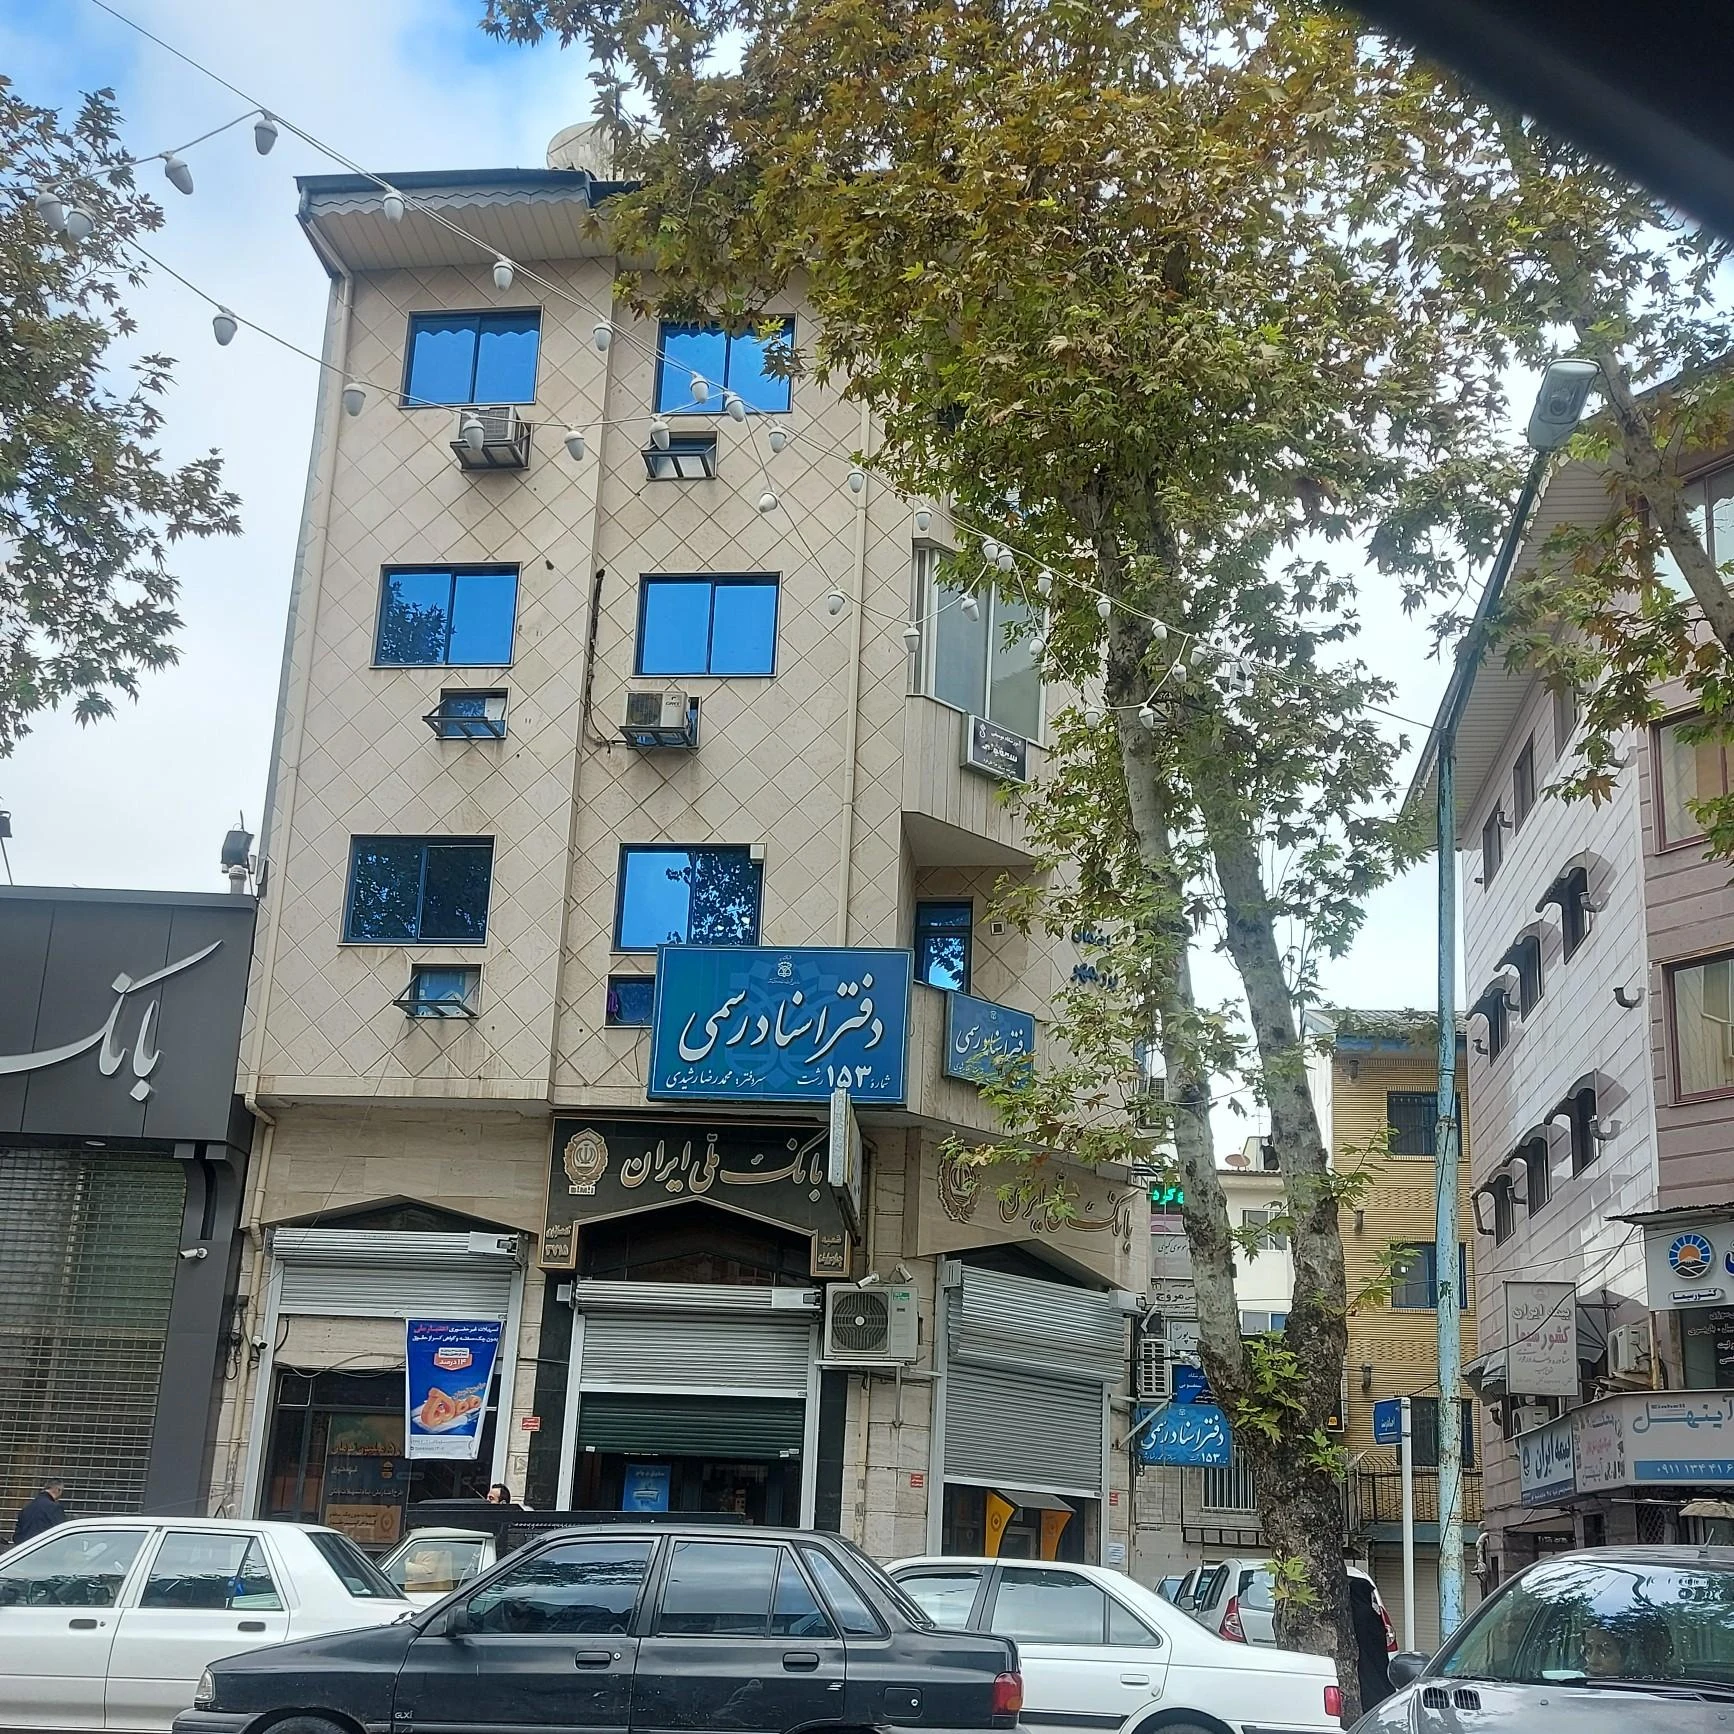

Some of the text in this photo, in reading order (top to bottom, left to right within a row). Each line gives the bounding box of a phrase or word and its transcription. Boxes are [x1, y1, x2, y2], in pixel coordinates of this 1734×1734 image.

[679, 973, 883, 1063] دفتر اسناد رسمی
[956, 1024, 981, 1054] رسمی
[665, 1066, 699, 1089] رشیدی
[797, 1067, 824, 1087] رشت
[827, 1064, 872, 1089] ۱۵۳
[620, 1139, 692, 1193] ایران
[720, 1126, 829, 1202] بانک
[1065, 1188, 1140, 1252] بانک
[1512, 1303, 1543, 1320] ایران
[1170, 1421, 1201, 1446] اسناد
[1192, 1413, 1224, 1453] دفتر
[1201, 1452, 1220, 1463] ۱۵۳
[1657, 1463, 1680, 1475] ۰۹۱۱
